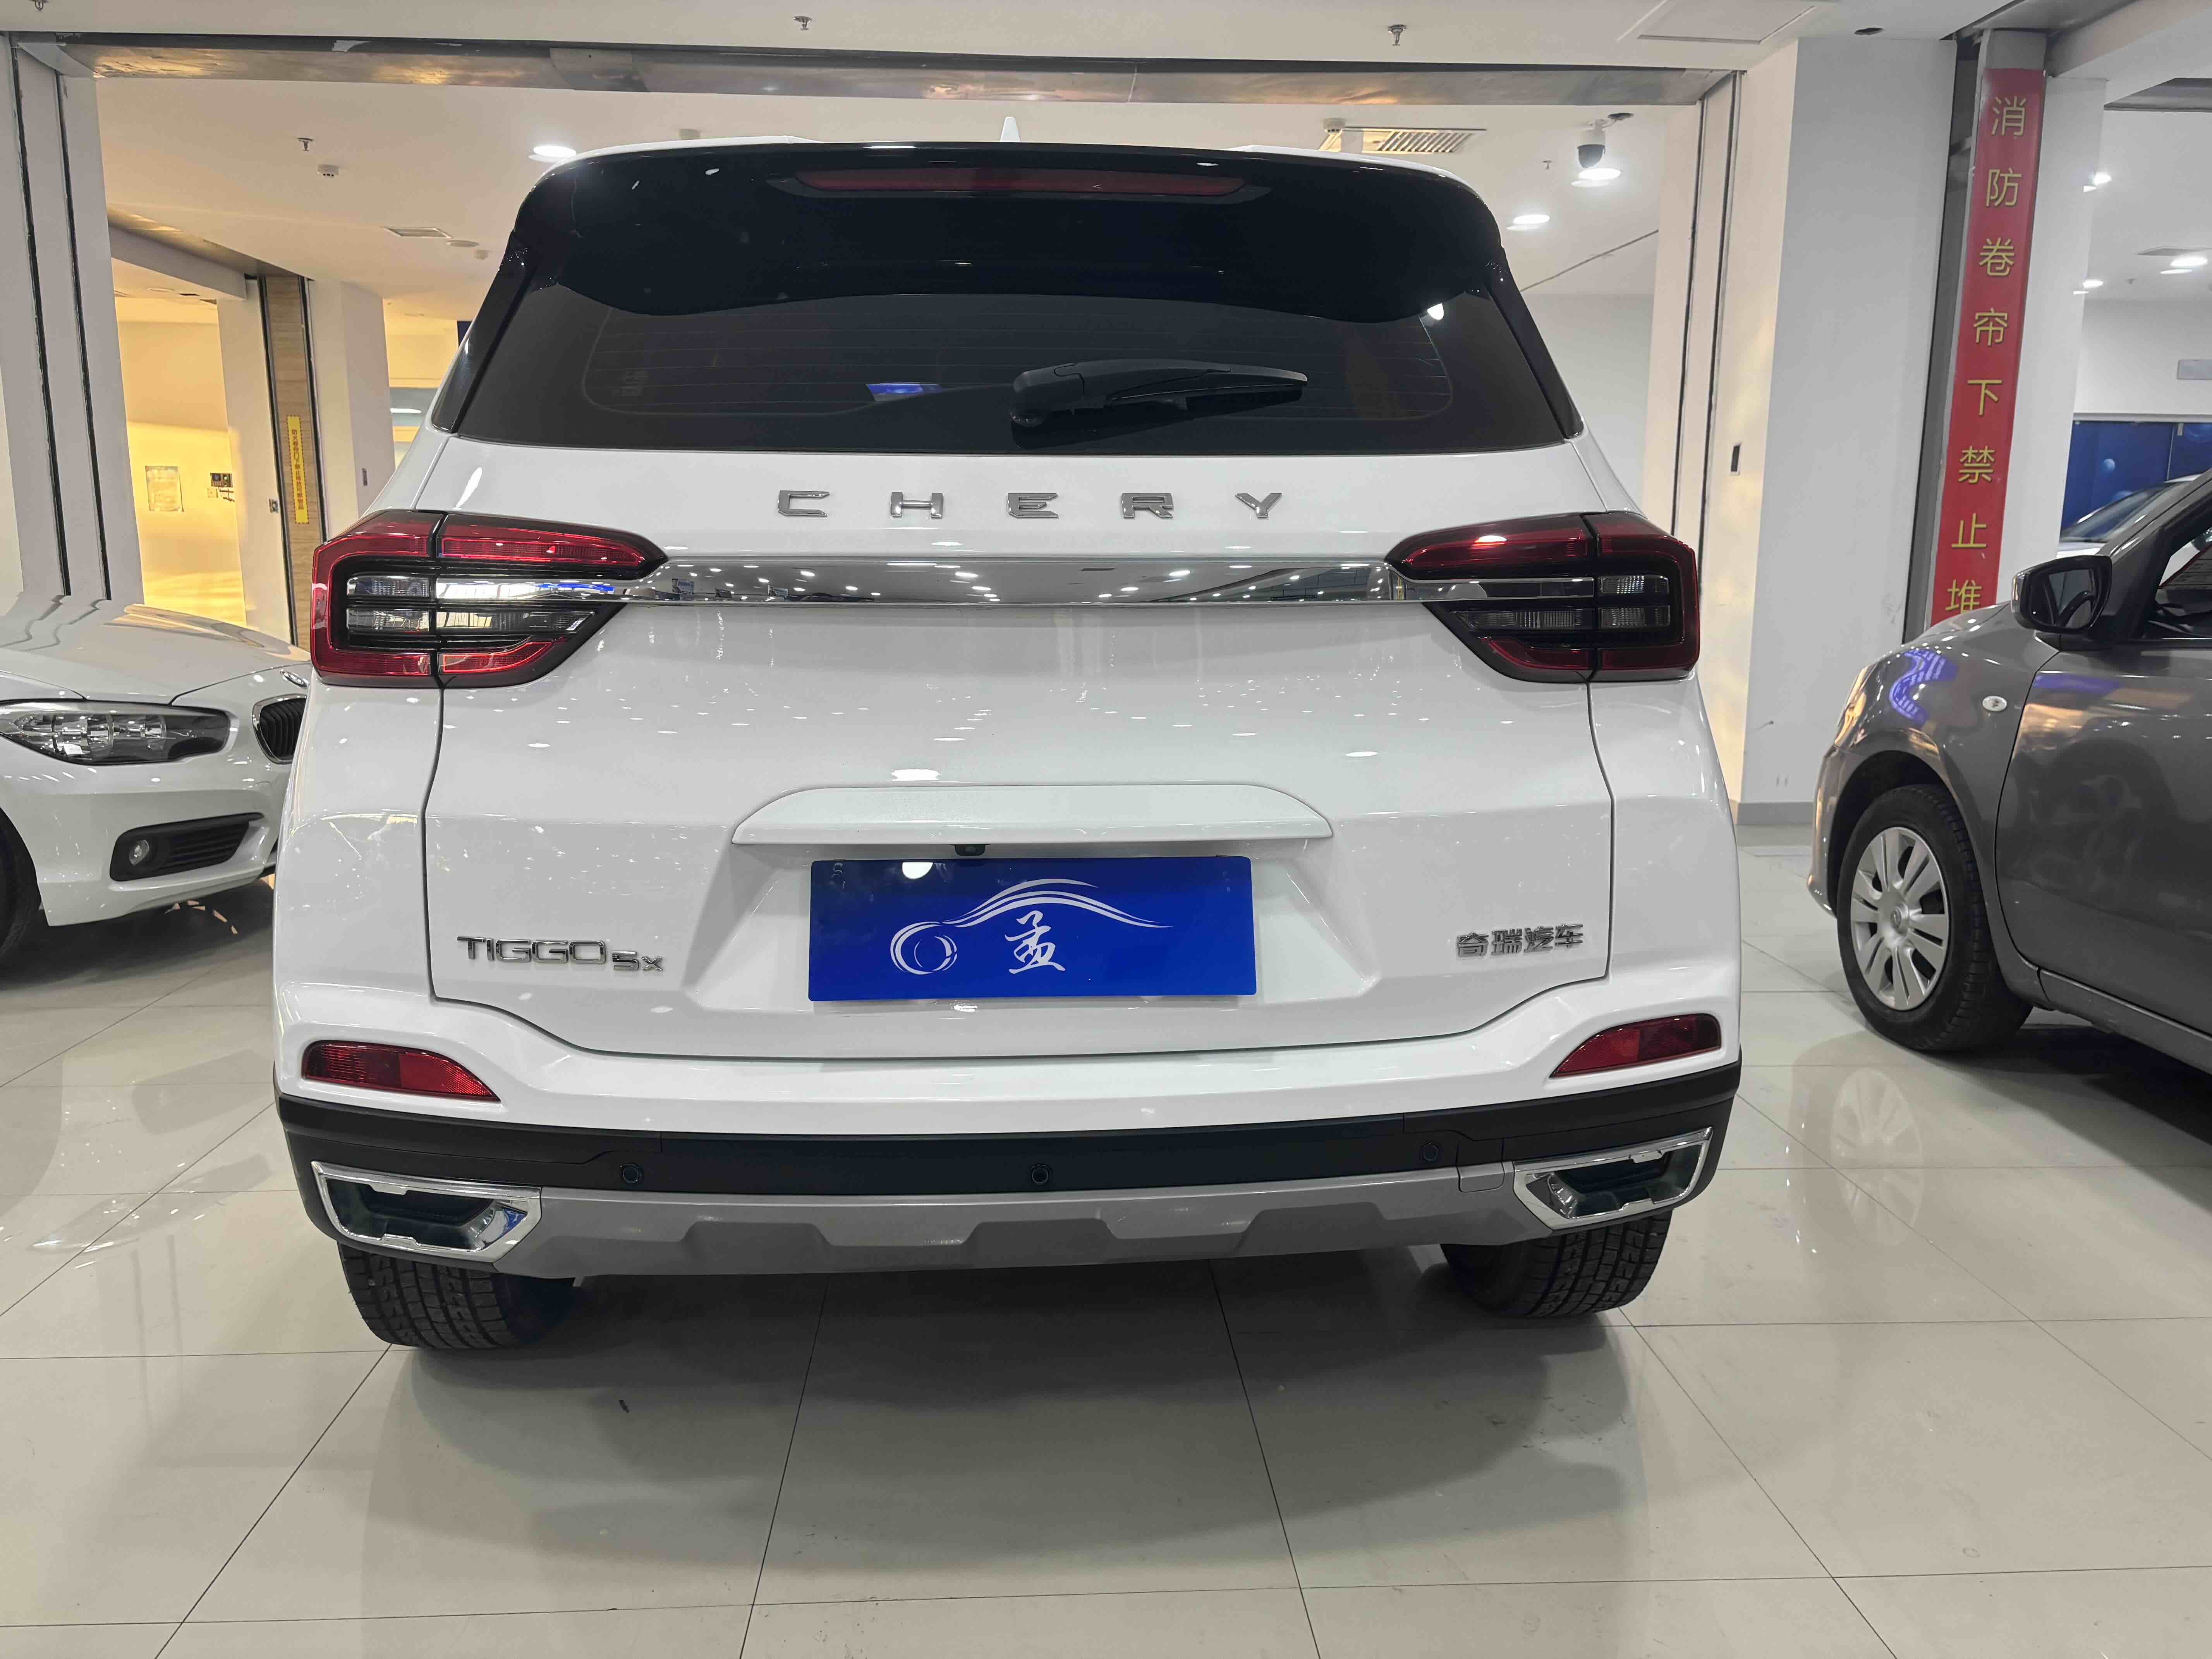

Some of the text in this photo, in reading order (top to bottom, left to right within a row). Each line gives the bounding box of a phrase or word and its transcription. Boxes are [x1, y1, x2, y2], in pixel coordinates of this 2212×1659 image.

[1946, 96, 2026, 614] 消防卷帘下禁止堆
[777, 489, 1282, 519] CHERY
[457, 936, 606, 964] TIGGO
[1457, 924, 1583, 957] 奇瑞汽车
